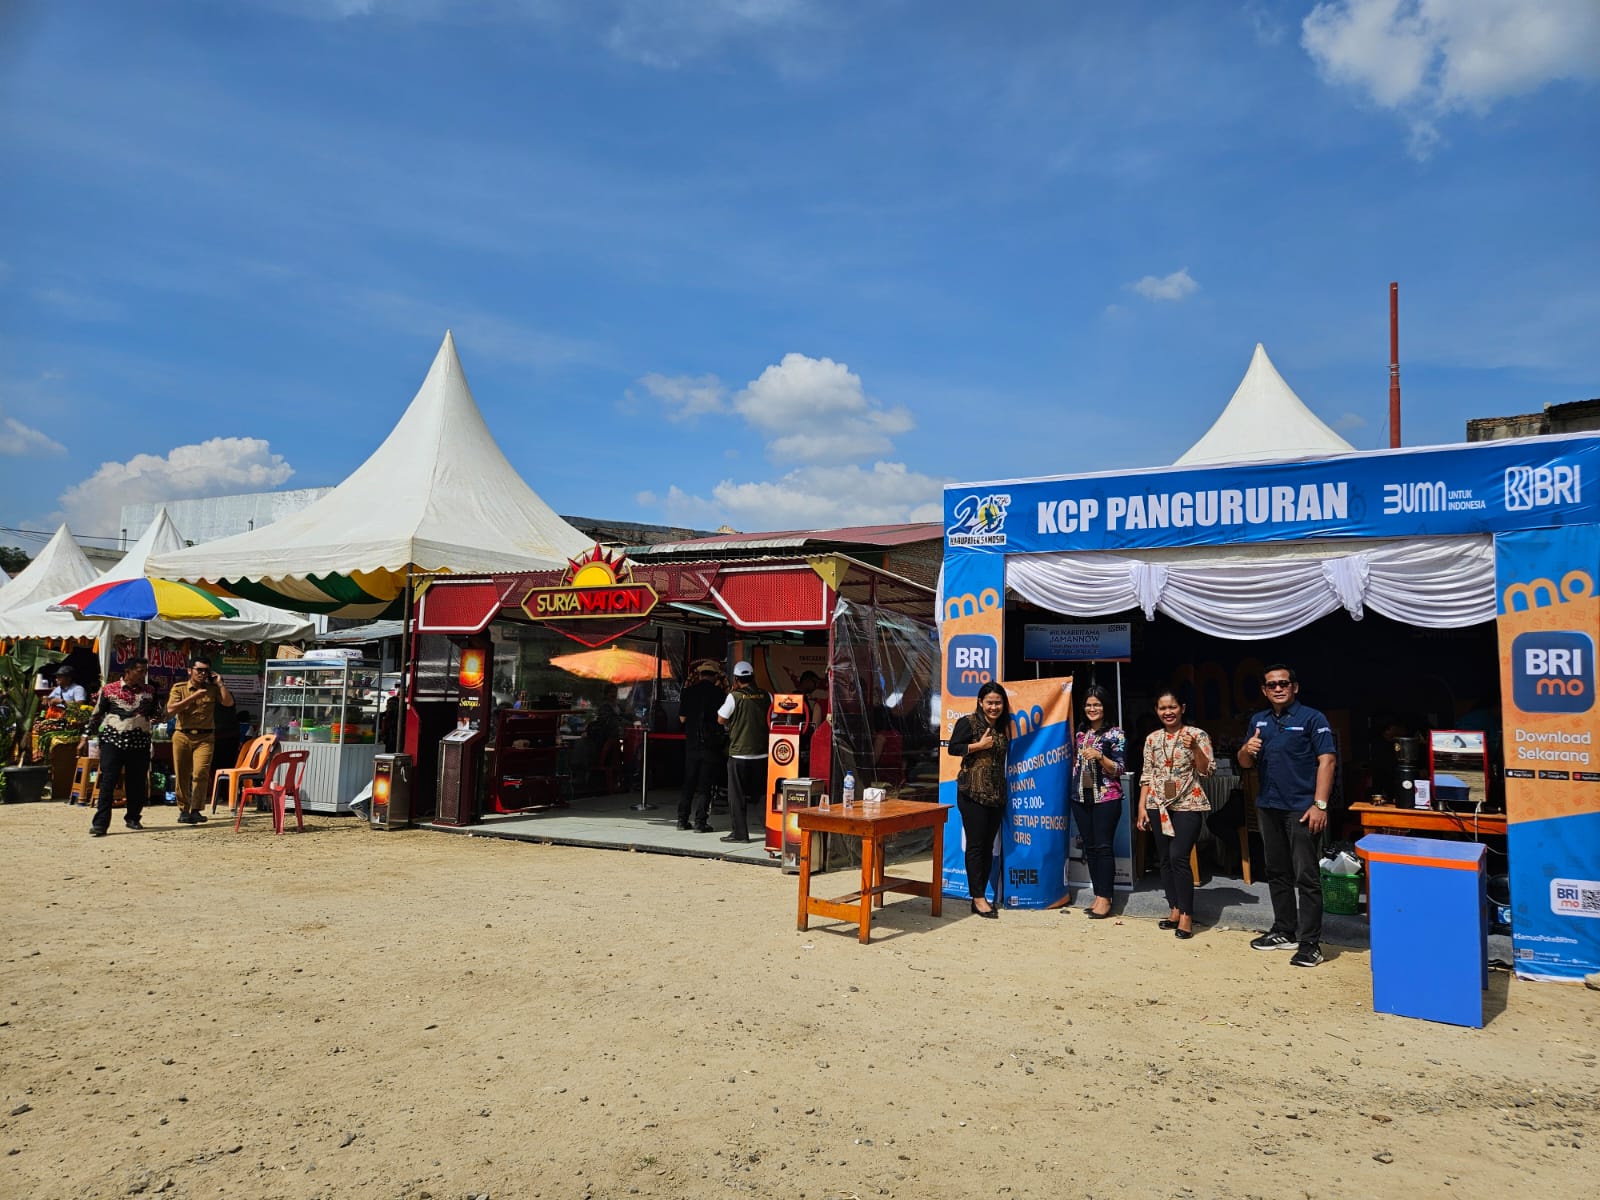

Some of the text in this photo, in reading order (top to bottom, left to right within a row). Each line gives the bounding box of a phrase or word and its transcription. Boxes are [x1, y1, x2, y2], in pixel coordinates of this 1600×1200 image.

[1448, 489, 1473, 500] UNTUK
[1535, 465, 1581, 506] BRI
[1383, 480, 1446, 515] BUMN
[1448, 500, 1486, 511] INDONESIA
[1037, 481, 1348, 534] KCP PANGURURAN
[536, 589, 640, 612] SURYANATION
[1502, 569, 1594, 613] mo
[944, 587, 1000, 621] mo
[955, 647, 990, 669] BRI
[1525, 648, 1582, 676] BRI
[961, 670, 991, 684] mo
[1536, 677, 1585, 696] mo
[1515, 729, 1592, 745] Download
[1008, 752, 1046, 777] PARDOSIR
[1517, 746, 1590, 765] Sekarang
[1010, 777, 1036, 793] HANYA
[1012, 798, 1023, 810] RP
[1013, 814, 1039, 829] SETIAP
[1014, 831, 1032, 846] QRIS
[1557, 887, 1579, 900] BRI
[1561, 900, 1580, 908] mo
